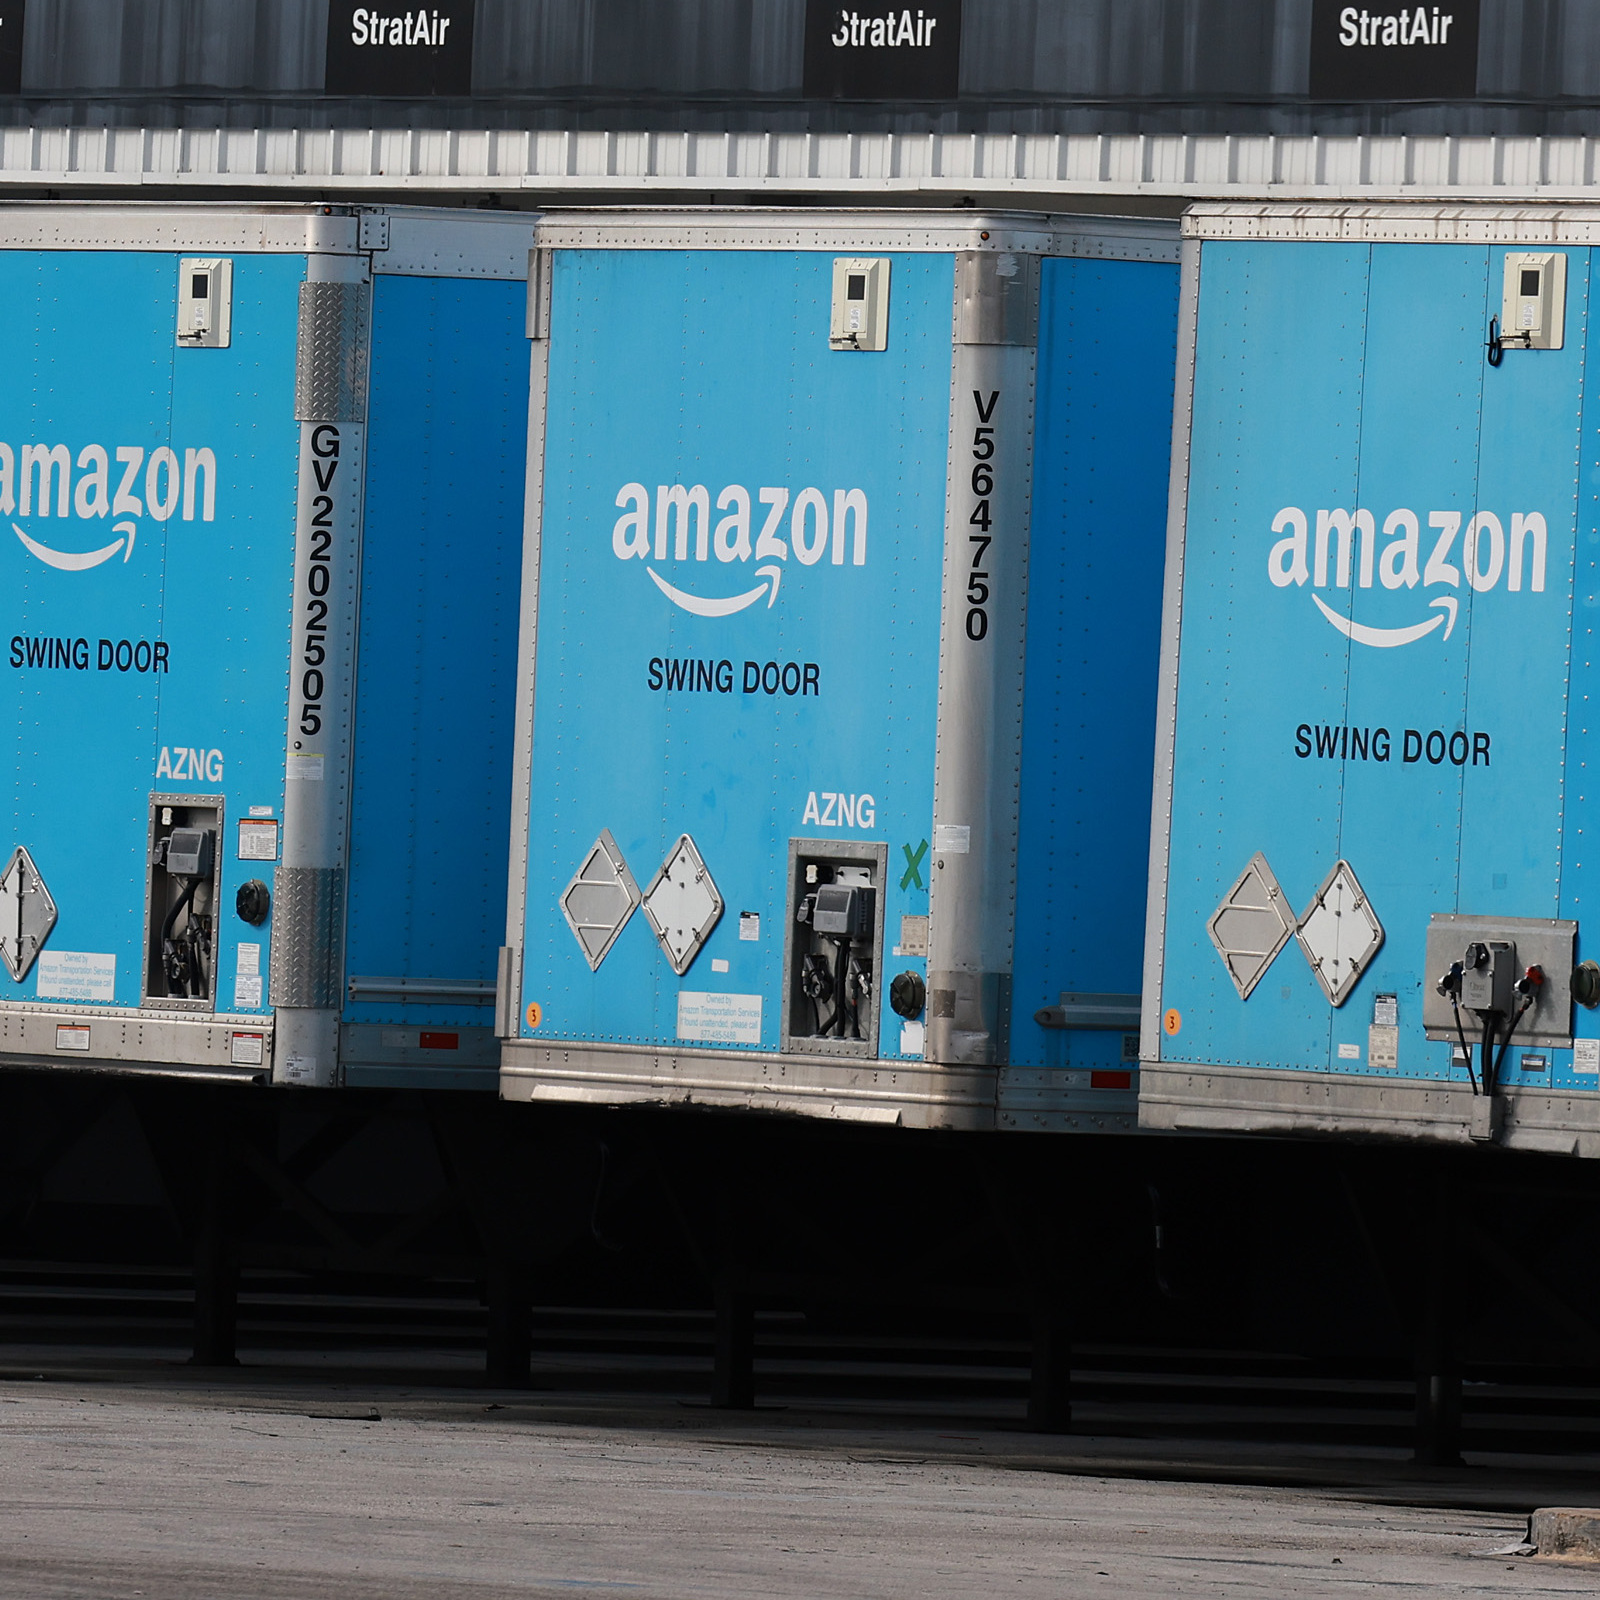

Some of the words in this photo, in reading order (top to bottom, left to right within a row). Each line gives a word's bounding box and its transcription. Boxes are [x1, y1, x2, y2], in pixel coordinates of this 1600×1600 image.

[352, 8, 450, 46] StratAir
[831, 9, 937, 47] StratAir
[1339, 7, 1453, 46] StratAir
[612, 482, 868, 566] amazon
[965, 390, 1000, 641] V564750
[1268, 506, 1548, 592] amazon
[300, 425, 340, 736] GV2202505
[9, 635, 89, 670] SWING
[97, 639, 169, 673] DOOR
[648, 658, 733, 693] SWING
[742, 661, 820, 696] DOOR
[1294, 723, 1391, 762] SWING
[1402, 729, 1491, 766] DOOR
[156, 746, 223, 782] AZNG
[802, 791, 876, 828] AZNG
[531, 1009, 537, 1022] 3
[1169, 1015, 1175, 1030] 3
